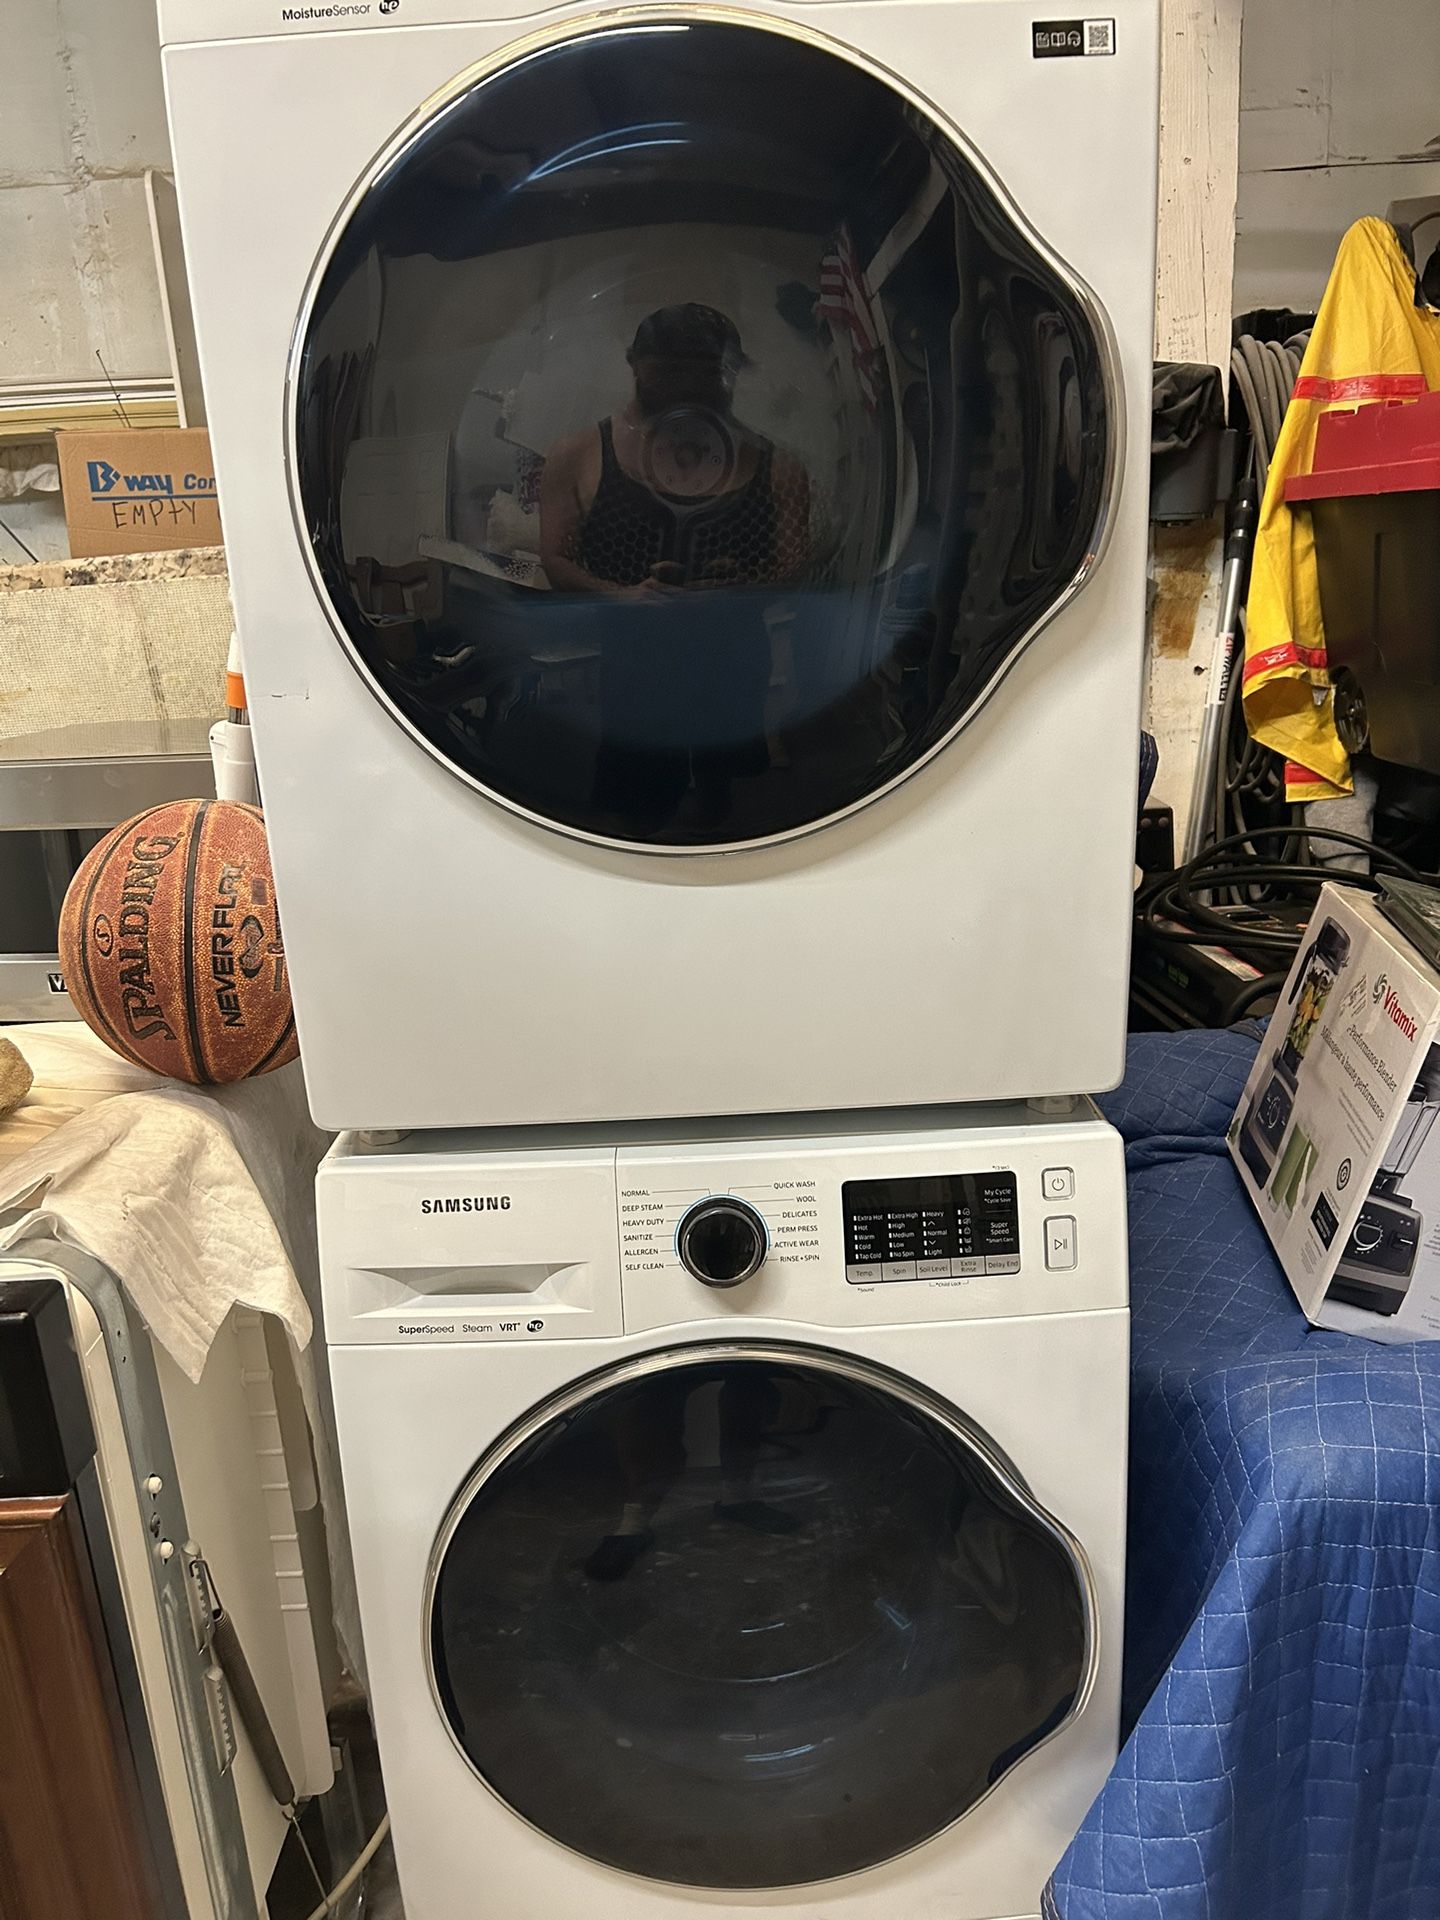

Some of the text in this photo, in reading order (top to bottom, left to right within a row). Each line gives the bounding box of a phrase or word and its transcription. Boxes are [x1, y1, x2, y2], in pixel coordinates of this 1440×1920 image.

[282, 4, 371, 20] MoistureSensor
[119, 833, 181, 1041] SPALDING
[211, 932, 245, 1028] NEVER
[1384, 985, 1417, 1041] Vitamix
[995, 1188, 1012, 1196] Cycle
[421, 1196, 511, 1214] SAMSUNG
[782, 1210, 818, 1218] DELICATES
[622, 1218, 665, 1227] HEAVY DUTY
[799, 1239, 819, 1247] WEAR
[624, 1248, 659, 1256] ALLERGEN
[902, 1250, 915, 1258] Spin
[919, 1264, 949, 1273] Soil Level
[399, 1325, 455, 1335] SuperSpeed
[462, 1324, 492, 1333] Steam
